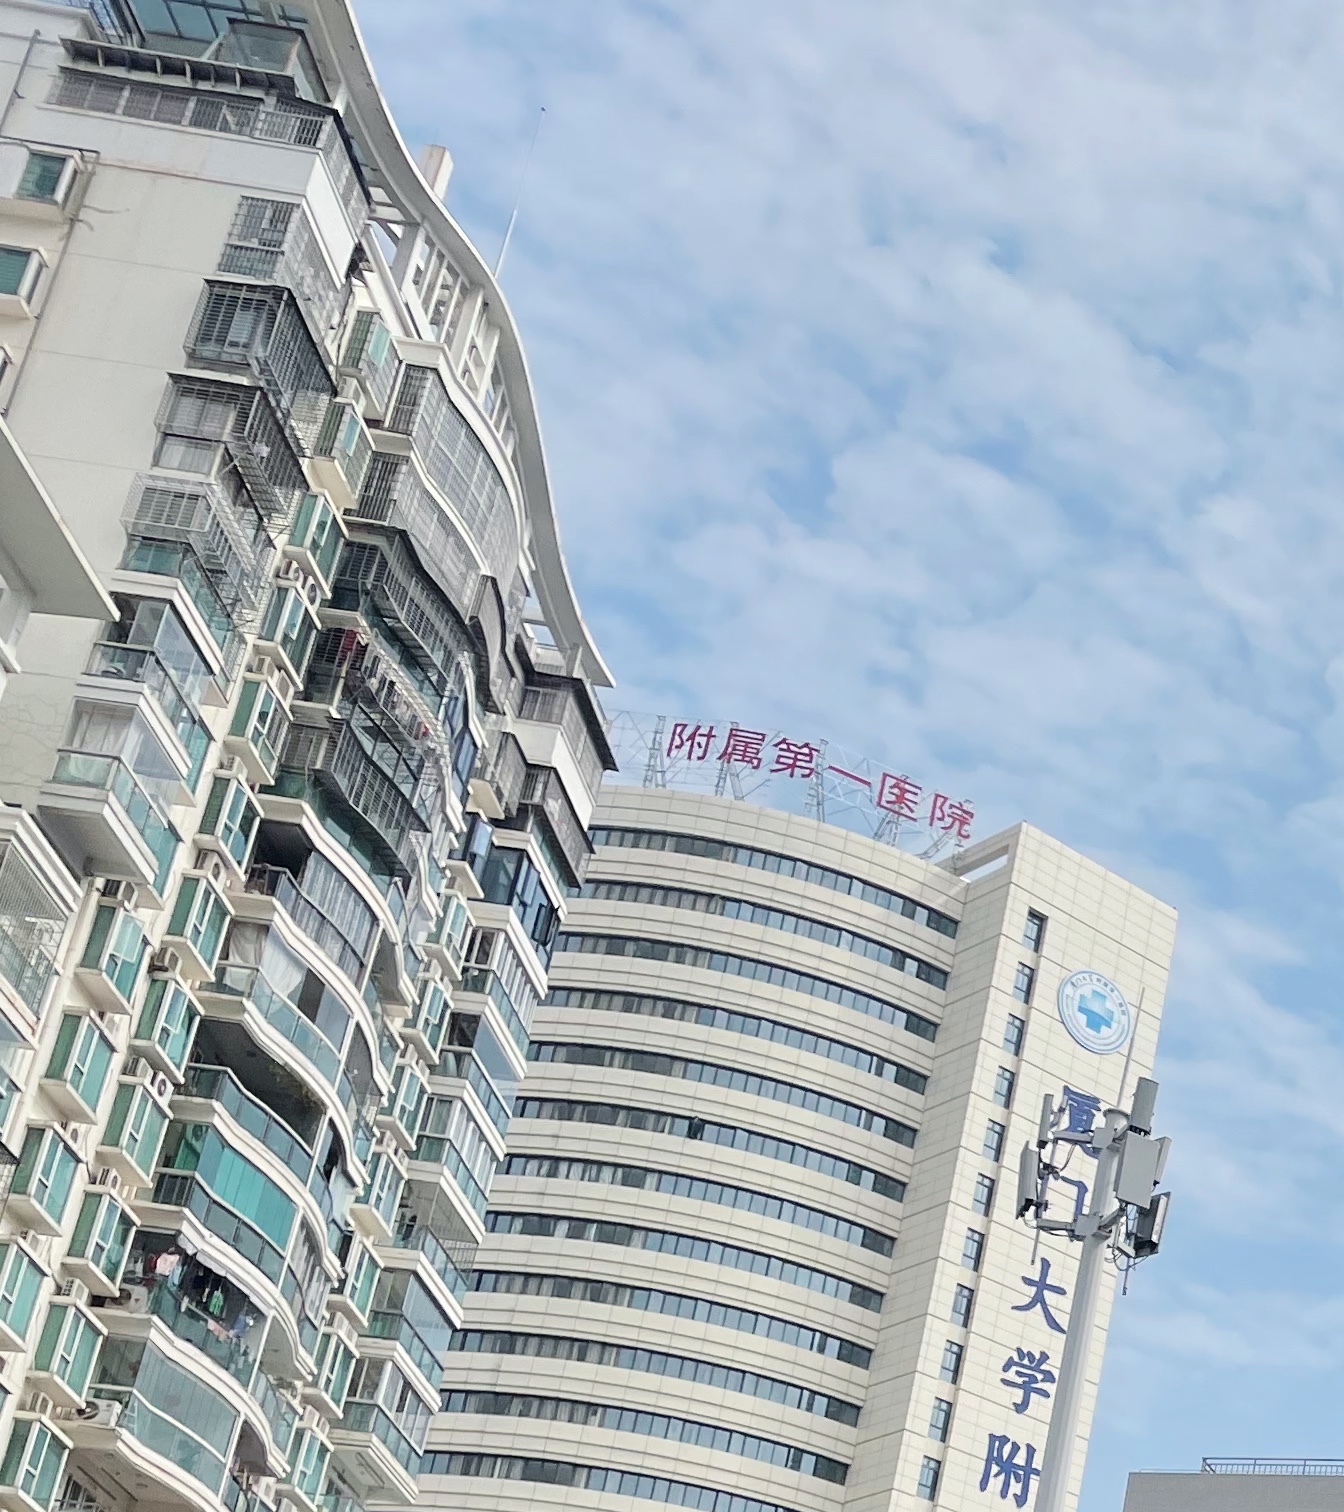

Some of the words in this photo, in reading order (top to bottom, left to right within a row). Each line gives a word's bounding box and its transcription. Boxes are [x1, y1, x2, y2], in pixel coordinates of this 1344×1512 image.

[666, 721, 976, 840] 附属第一医院
